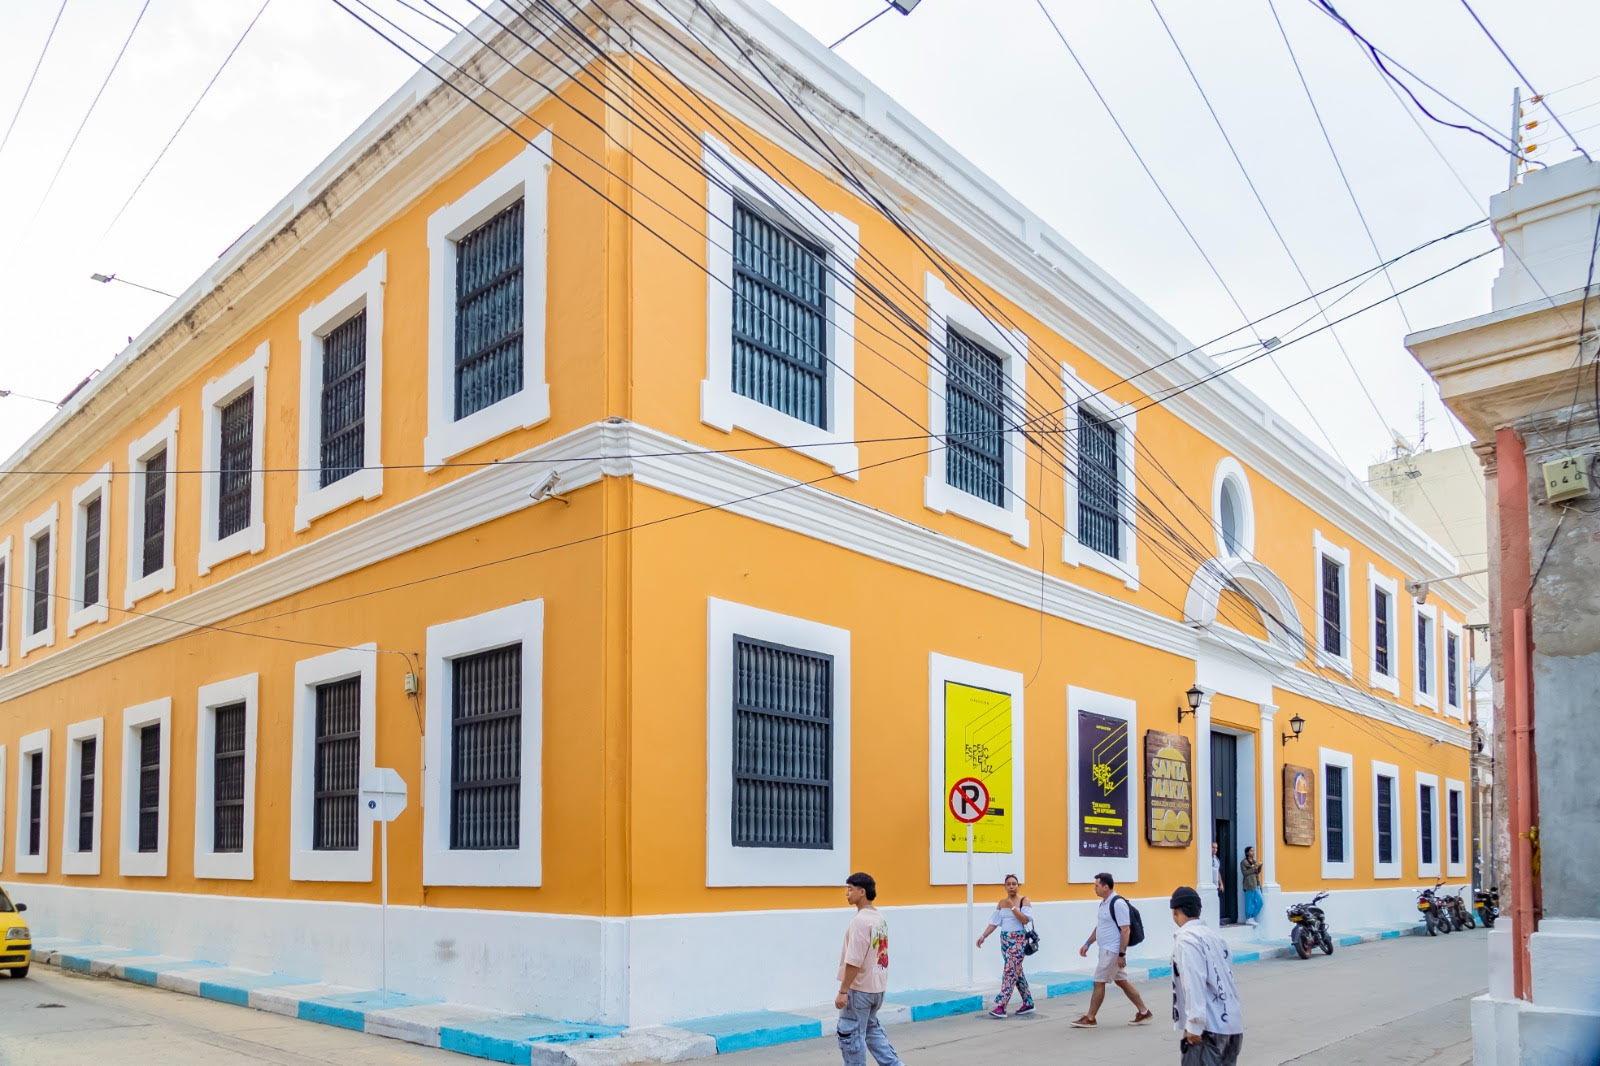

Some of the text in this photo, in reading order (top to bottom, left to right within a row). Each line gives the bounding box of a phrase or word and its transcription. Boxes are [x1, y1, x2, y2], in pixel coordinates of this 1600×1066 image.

[1152, 757, 1189, 781] SANTA
[961, 785, 980, 814] P
[1151, 777, 1189, 800] MARTA
